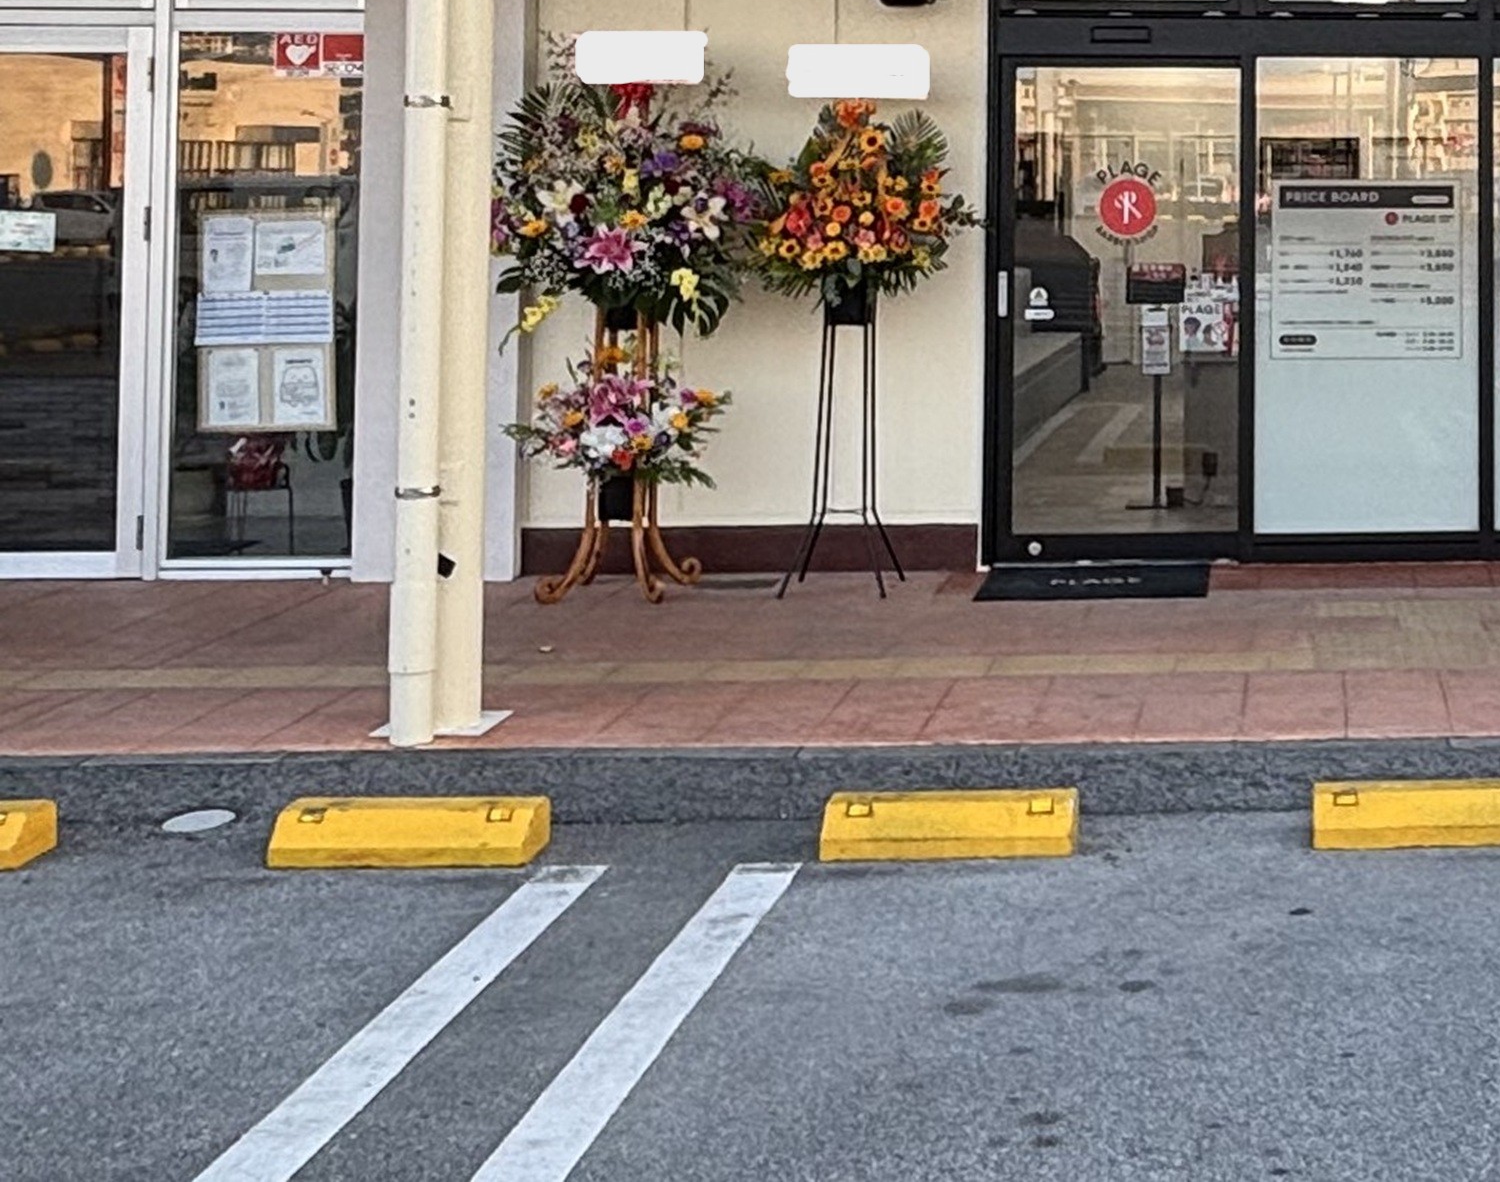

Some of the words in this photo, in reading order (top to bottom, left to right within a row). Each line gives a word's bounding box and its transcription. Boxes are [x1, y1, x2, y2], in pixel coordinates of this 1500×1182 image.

[279, 33, 319, 45] AED
[1096, 160, 1162, 186] PLAGE
[1285, 191, 1326, 203] PRICE
[1331, 191, 1380, 203] BOARD
